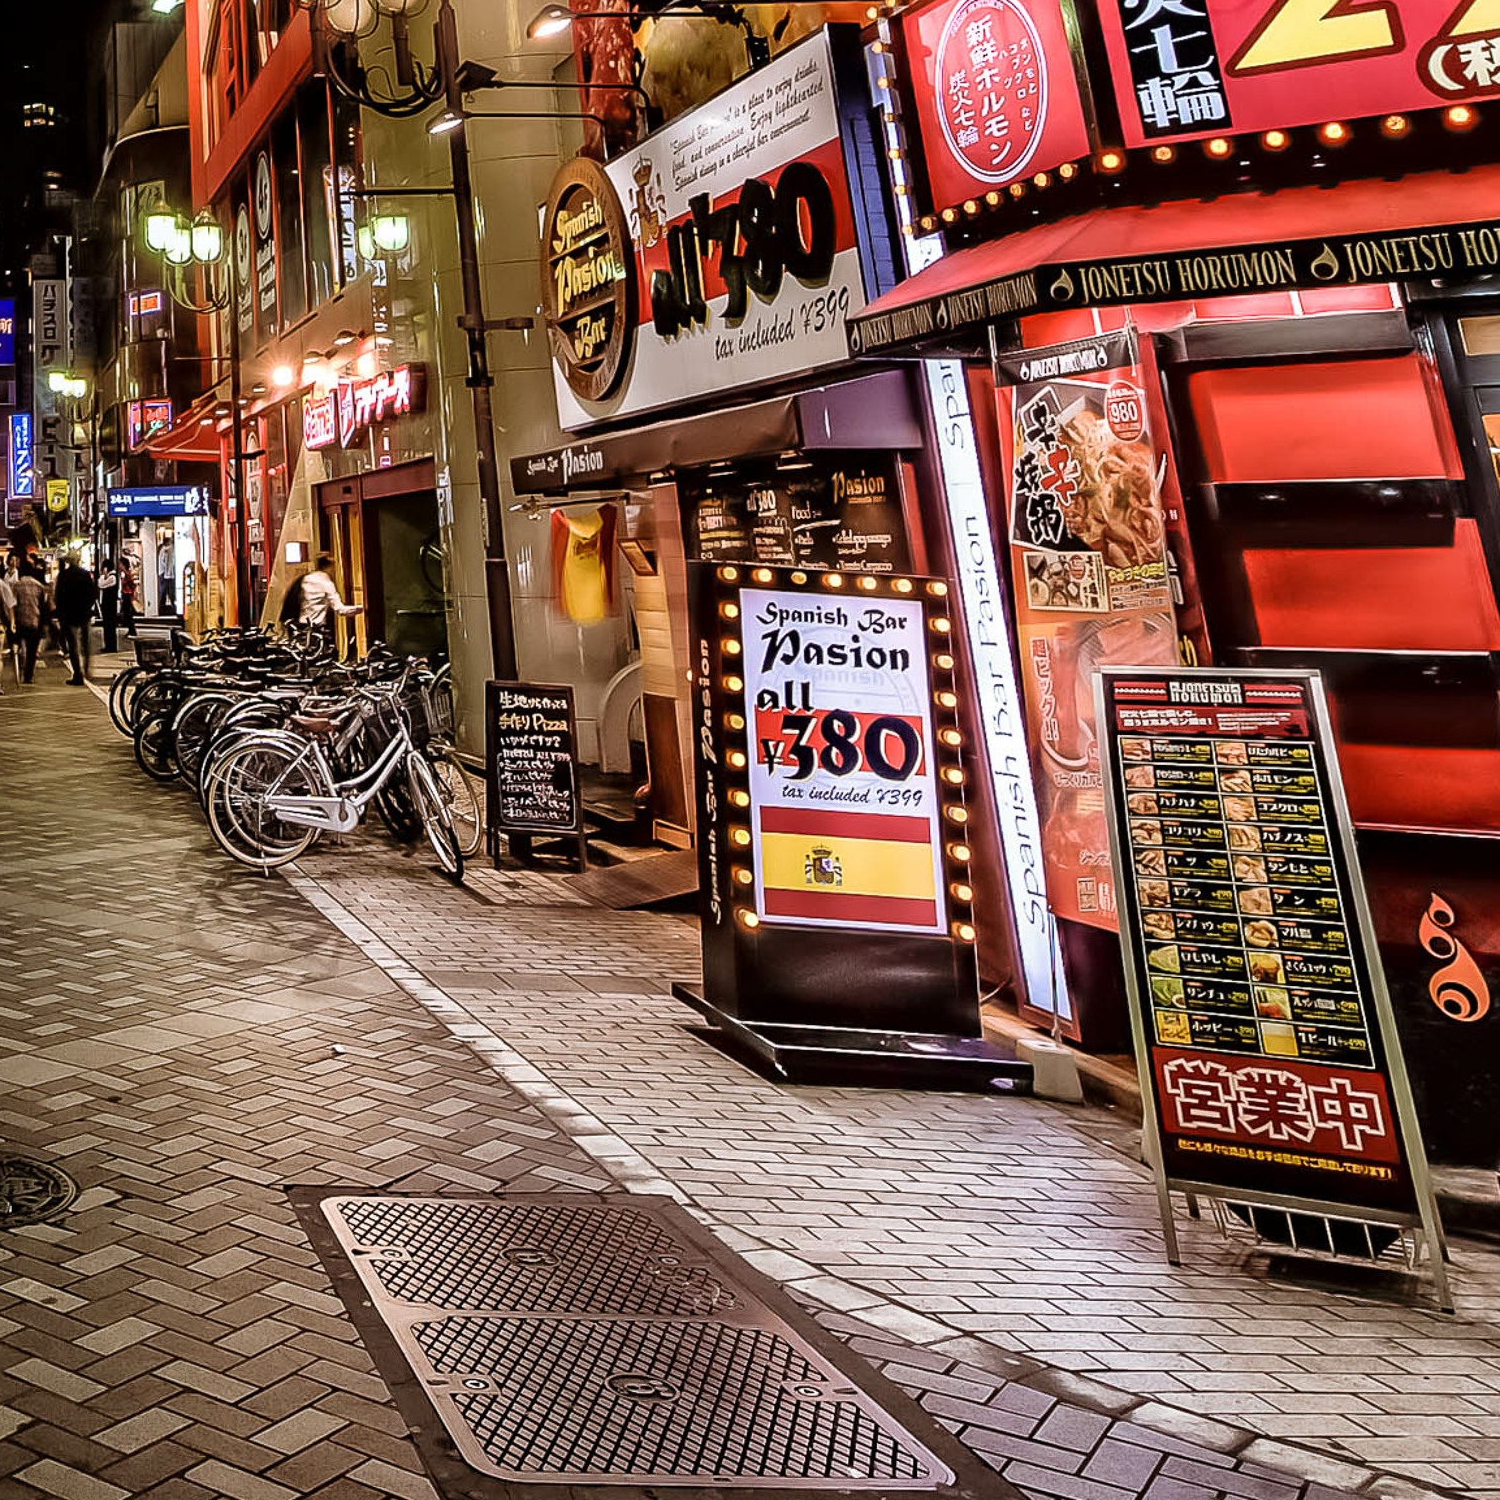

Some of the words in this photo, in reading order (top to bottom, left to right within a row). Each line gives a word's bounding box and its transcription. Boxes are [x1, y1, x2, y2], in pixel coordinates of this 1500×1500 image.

[948, 68, 980, 148] 炭火七輪
[966, 14, 1012, 166] 新鮮ホルモン
[553, 196, 603, 254] Spanish
[555, 245, 619, 319] Pasion
[1079, 259, 1171, 304] JONETSU
[1174, 247, 1299, 290] HORUMON
[1344, 233, 1455, 282] JONETSU
[948, 290, 987, 330] JONETSU
[986, 273, 1038, 316] HORUMON
[574, 315, 606, 359] Bar
[714, 334, 736, 362] tax
[738, 307, 797, 352] included
[561, 445, 604, 485] Pasion
[831, 469, 886, 505] Pasion
[962, 513, 999, 649] Pasion
[756, 601, 849, 630] Spanish
[856, 608, 909, 635] Bar
[761, 627, 911, 674] Pasion
[531, 712, 569, 732] Pizza
[700, 638, 718, 765] Pasion
[756, 680, 815, 713] all
[760, 709, 922, 782] ¥380
[781, 784, 806, 801] tax
[808, 784, 871, 804] included
[994, 754, 1046, 934] Spanish
[1162, 1057, 1387, 1152] 営業中
